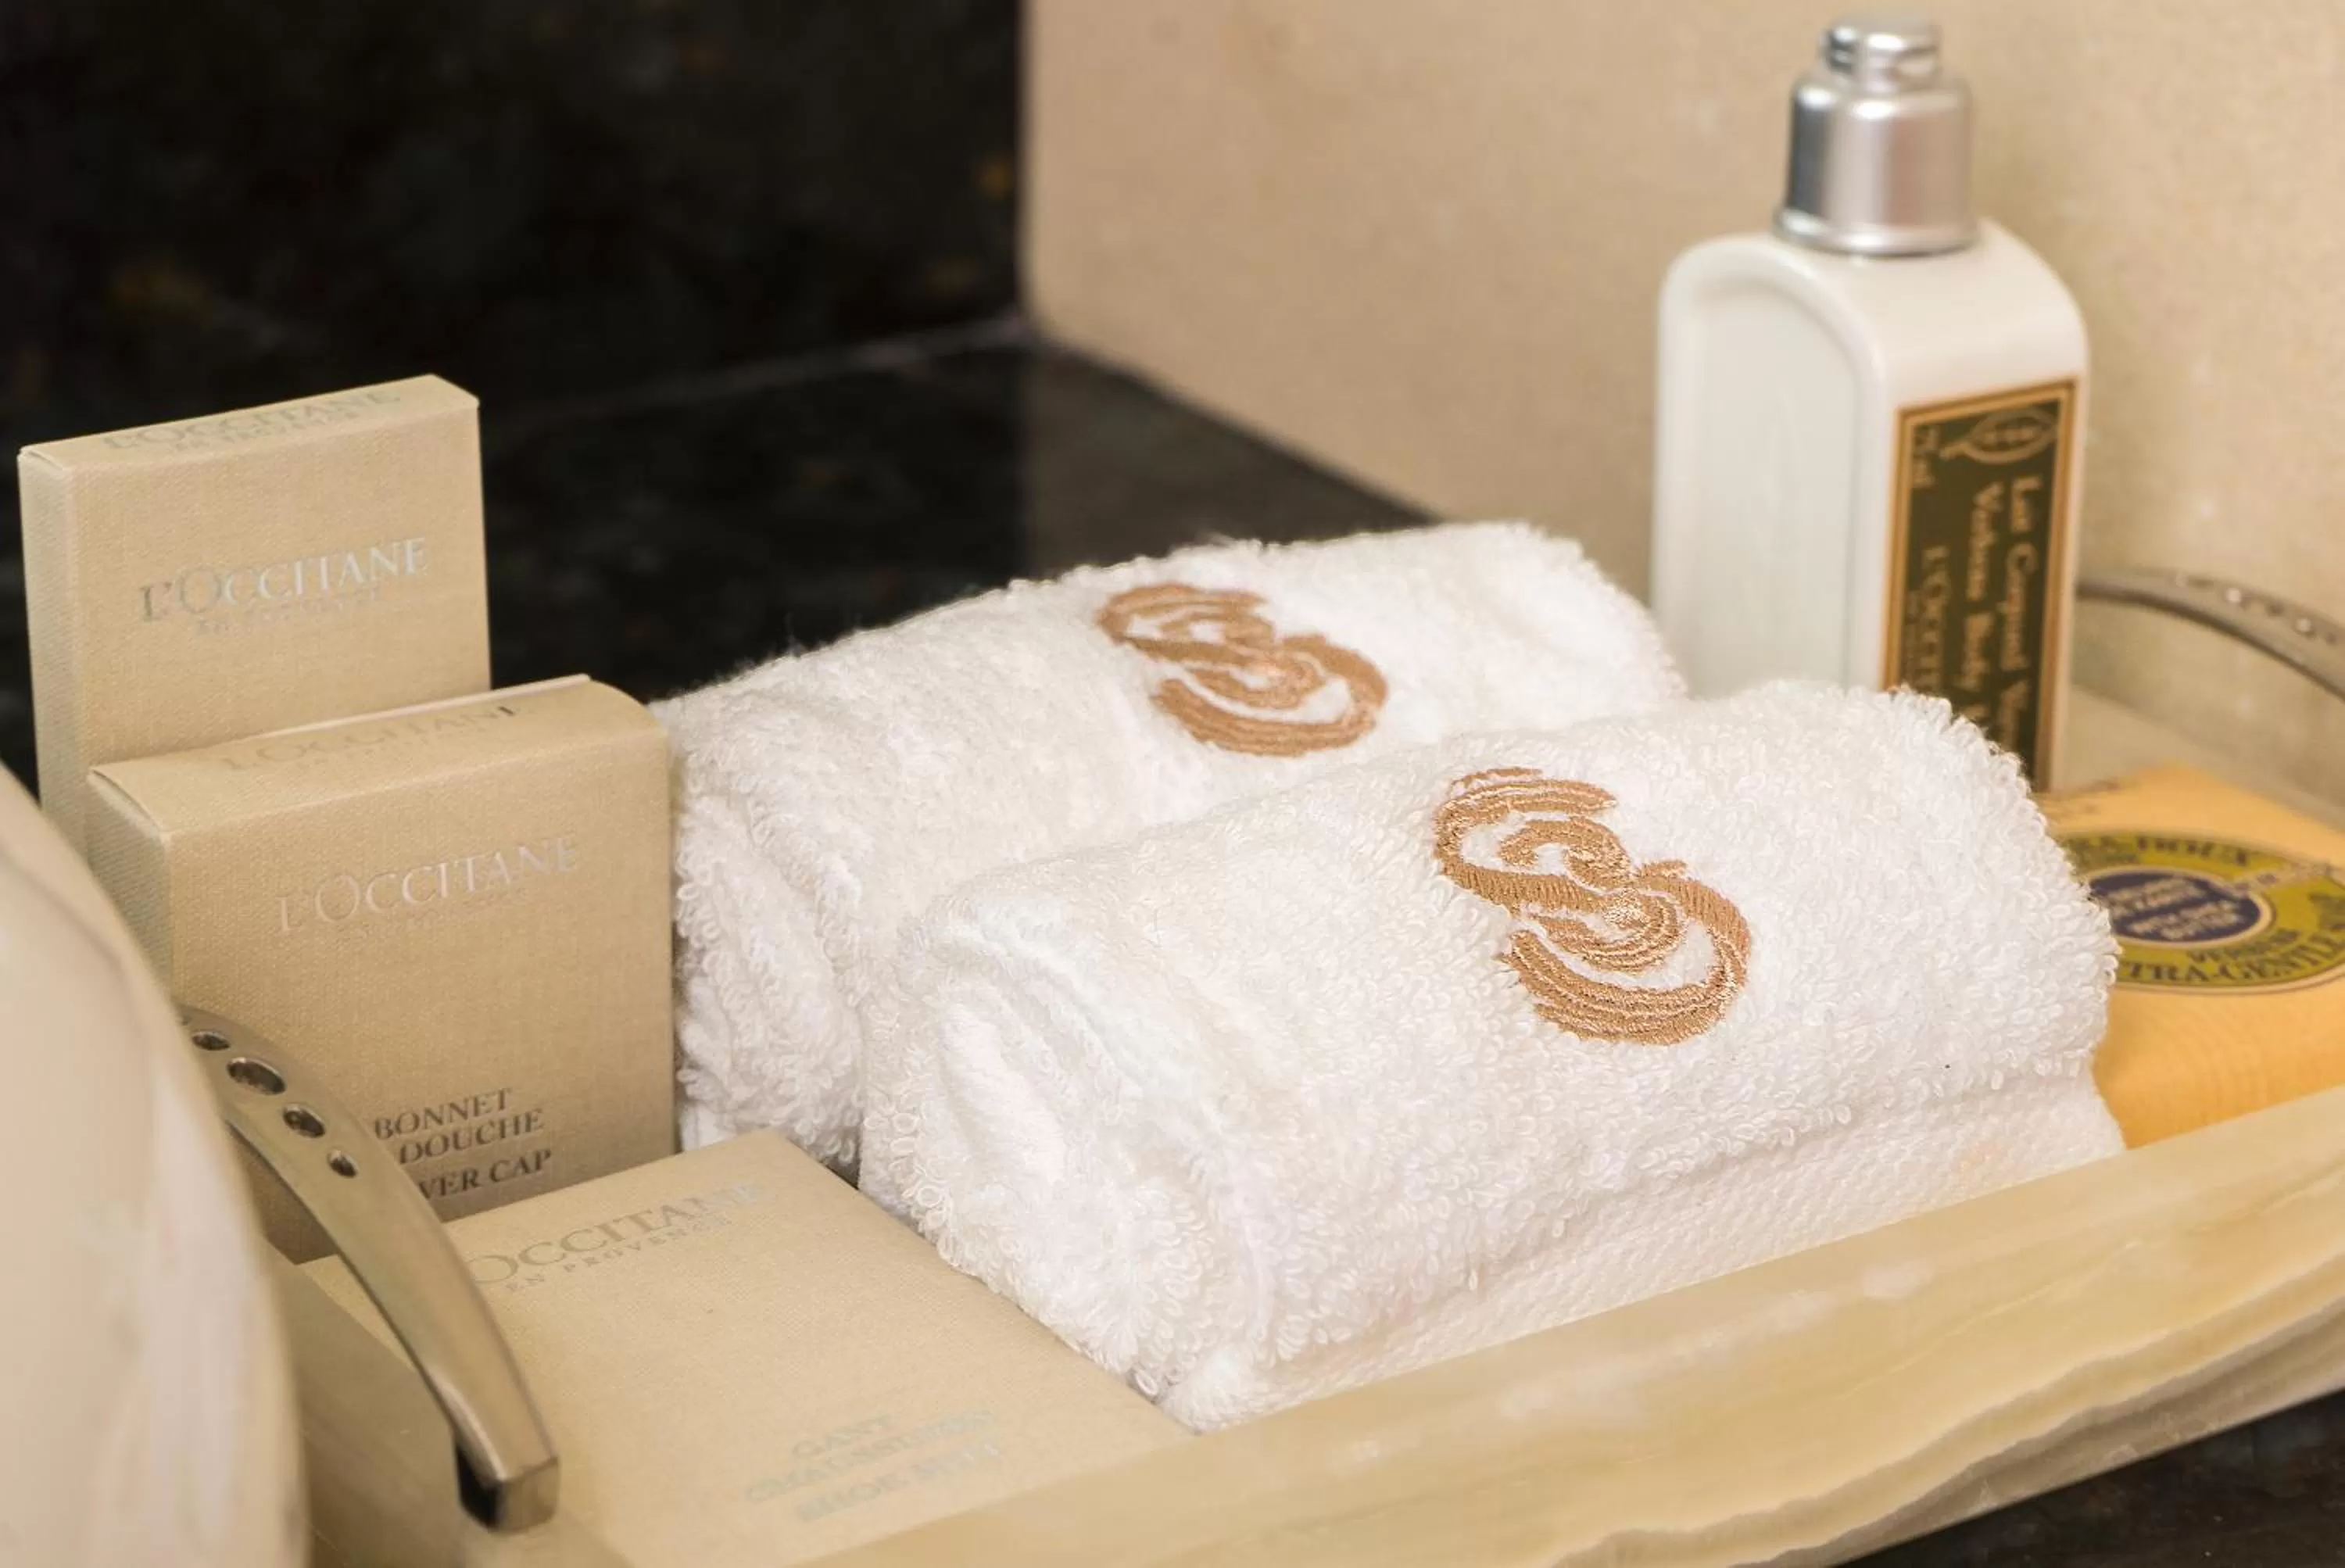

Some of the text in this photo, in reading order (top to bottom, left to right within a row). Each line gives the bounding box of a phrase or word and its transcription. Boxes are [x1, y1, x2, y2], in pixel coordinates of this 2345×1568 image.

[139, 537, 428, 623] L'OCCITANE
[276, 830, 578, 934] L'OCCITANE
[374, 1087, 513, 1140] BONNET
[399, 1108, 546, 1165] DOUCHE
[488, 1148, 552, 1183] CAP
[469, 1182, 761, 1285] OCCITANE
